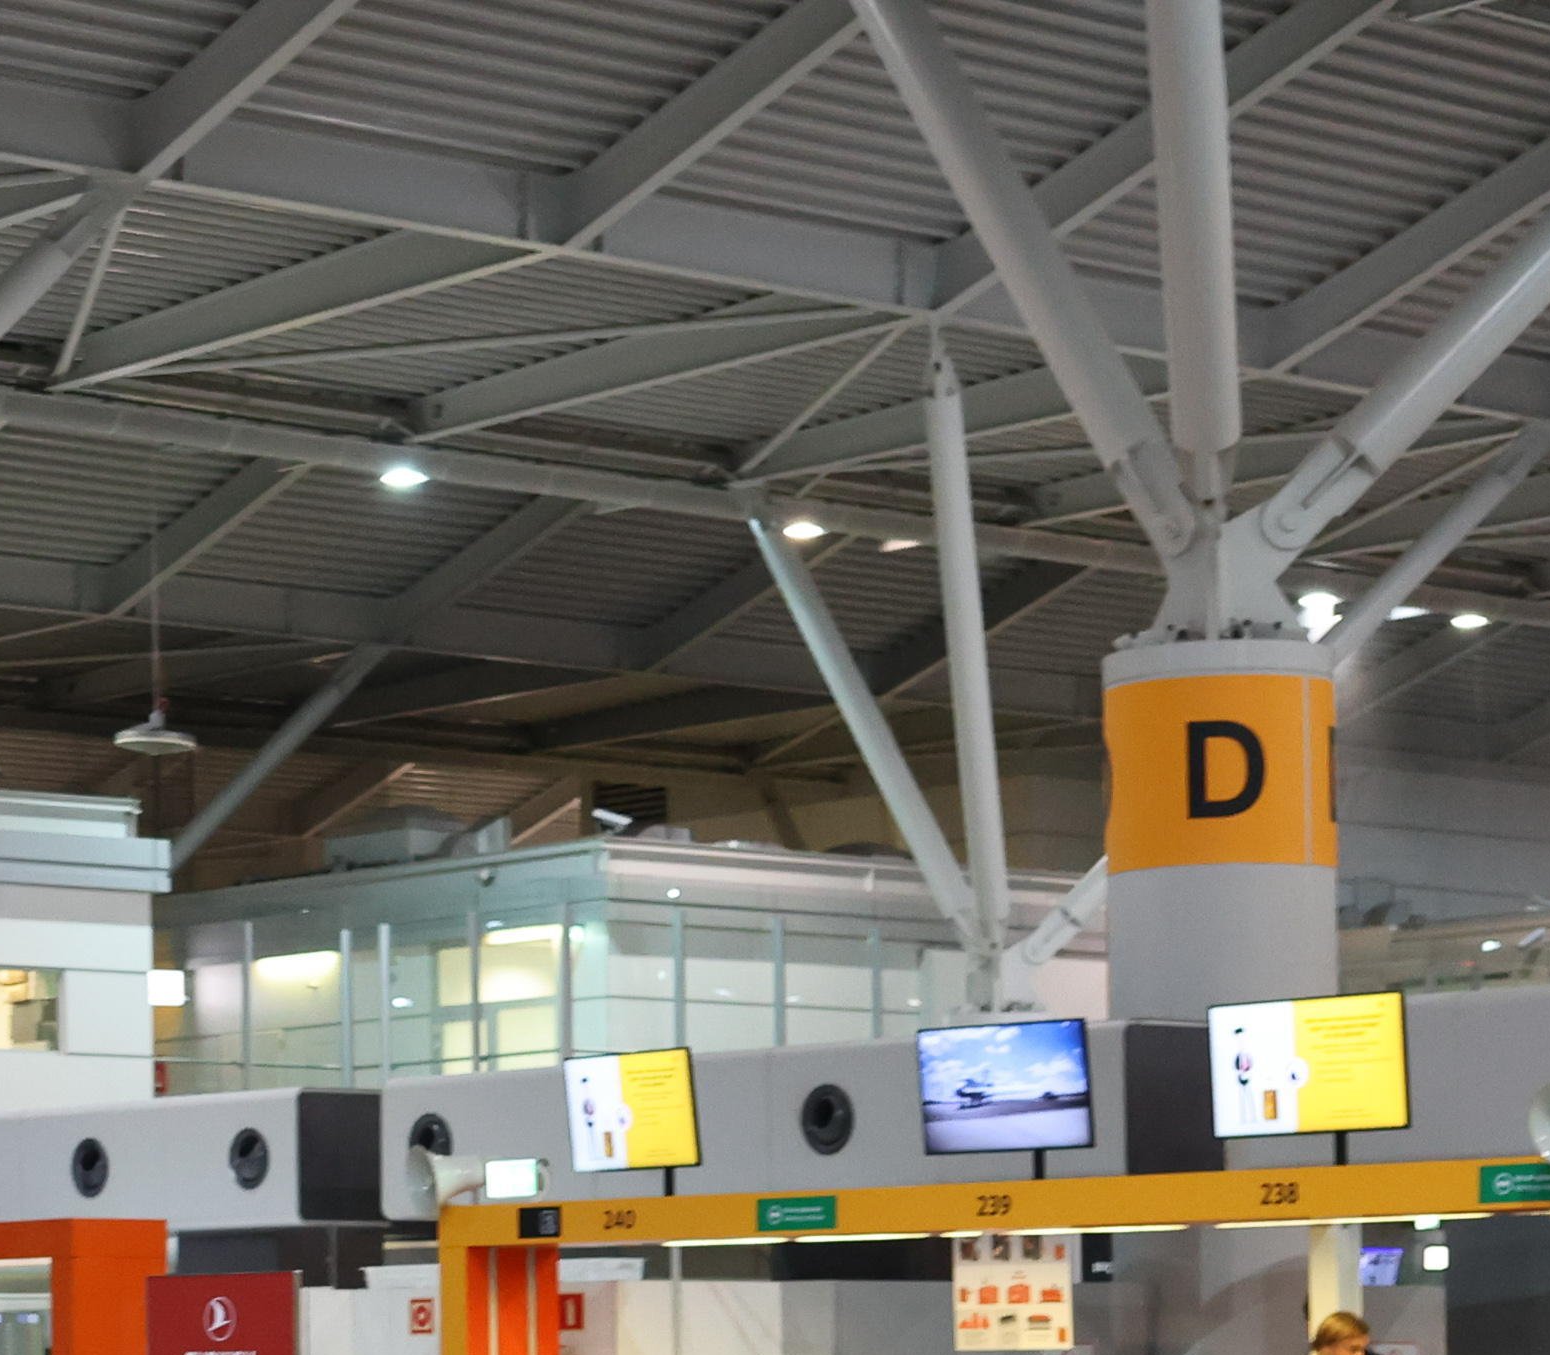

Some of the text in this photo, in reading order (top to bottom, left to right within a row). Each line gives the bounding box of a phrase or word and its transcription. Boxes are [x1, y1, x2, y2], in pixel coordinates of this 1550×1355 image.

[1186, 720, 1267, 820] D
[1260, 1183, 1300, 1205] 238
[976, 1195, 1012, 1217] 239
